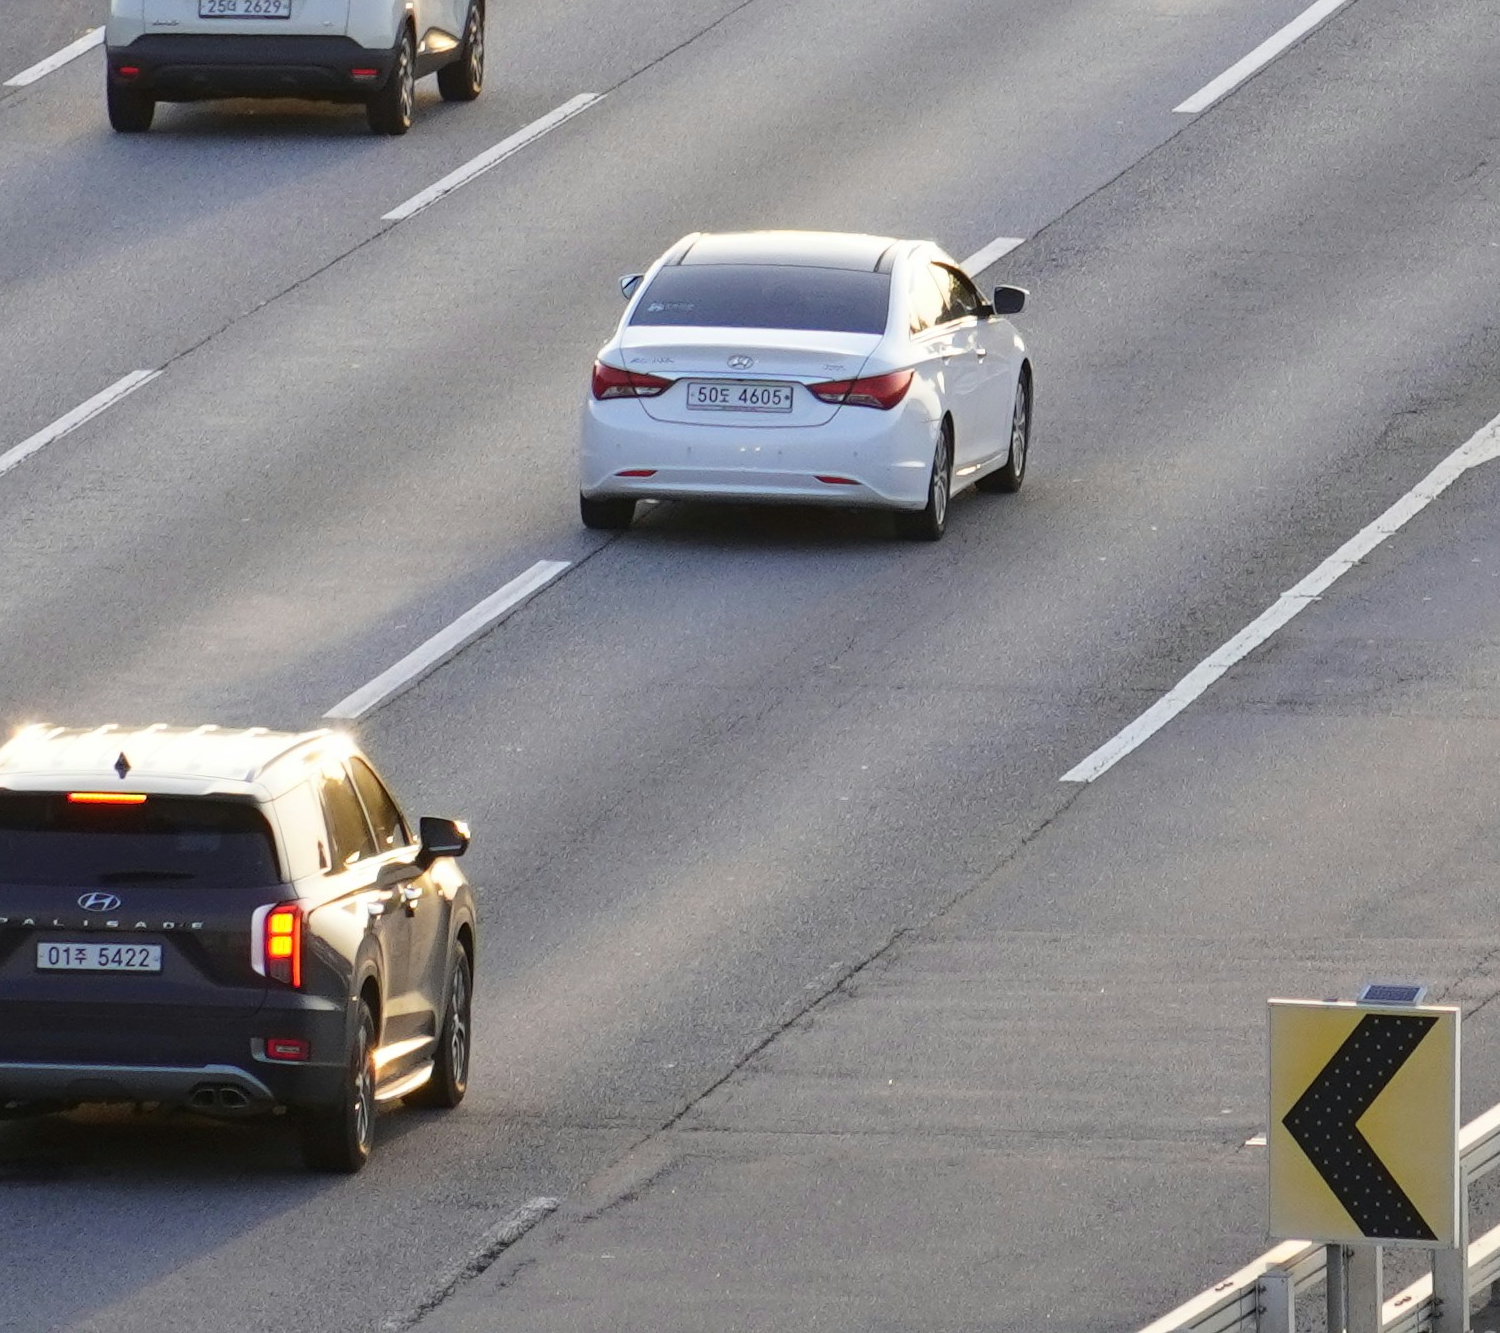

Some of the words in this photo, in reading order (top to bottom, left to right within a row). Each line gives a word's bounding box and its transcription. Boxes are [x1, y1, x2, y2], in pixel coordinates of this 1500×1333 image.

[697, 385, 729, 405] 50도
[739, 388, 783, 406] 4605
[48, 946, 88, 966] 01주
[98, 947, 151, 967] 5422
